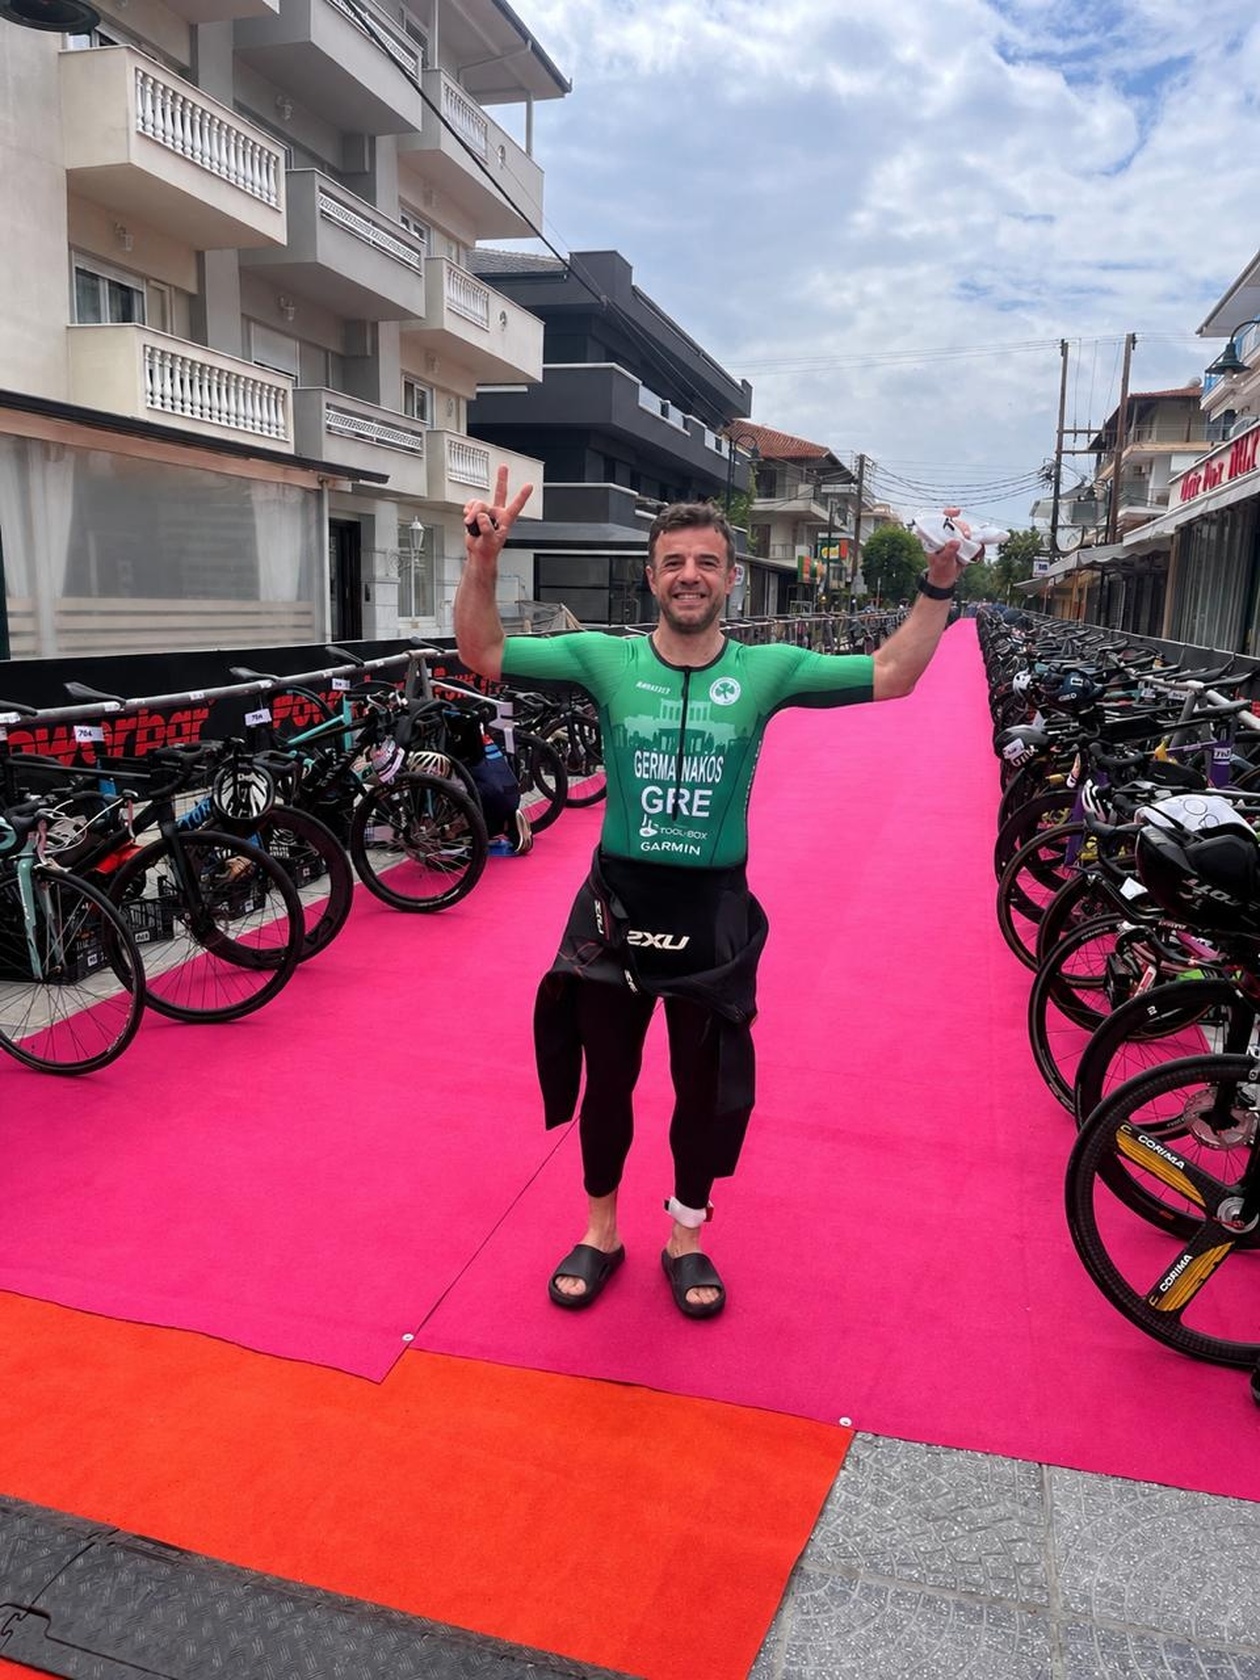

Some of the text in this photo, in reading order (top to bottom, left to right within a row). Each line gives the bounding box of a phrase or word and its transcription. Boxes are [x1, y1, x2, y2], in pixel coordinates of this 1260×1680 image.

[8, 708, 209, 767] owerbar
[641, 786, 713, 817] GRE
[641, 841, 701, 856] GARMIN
[626, 930, 690, 950] 2XU
[1138, 1134, 1185, 1170] CORIMA
[1159, 1254, 1194, 1292] CORIMA
